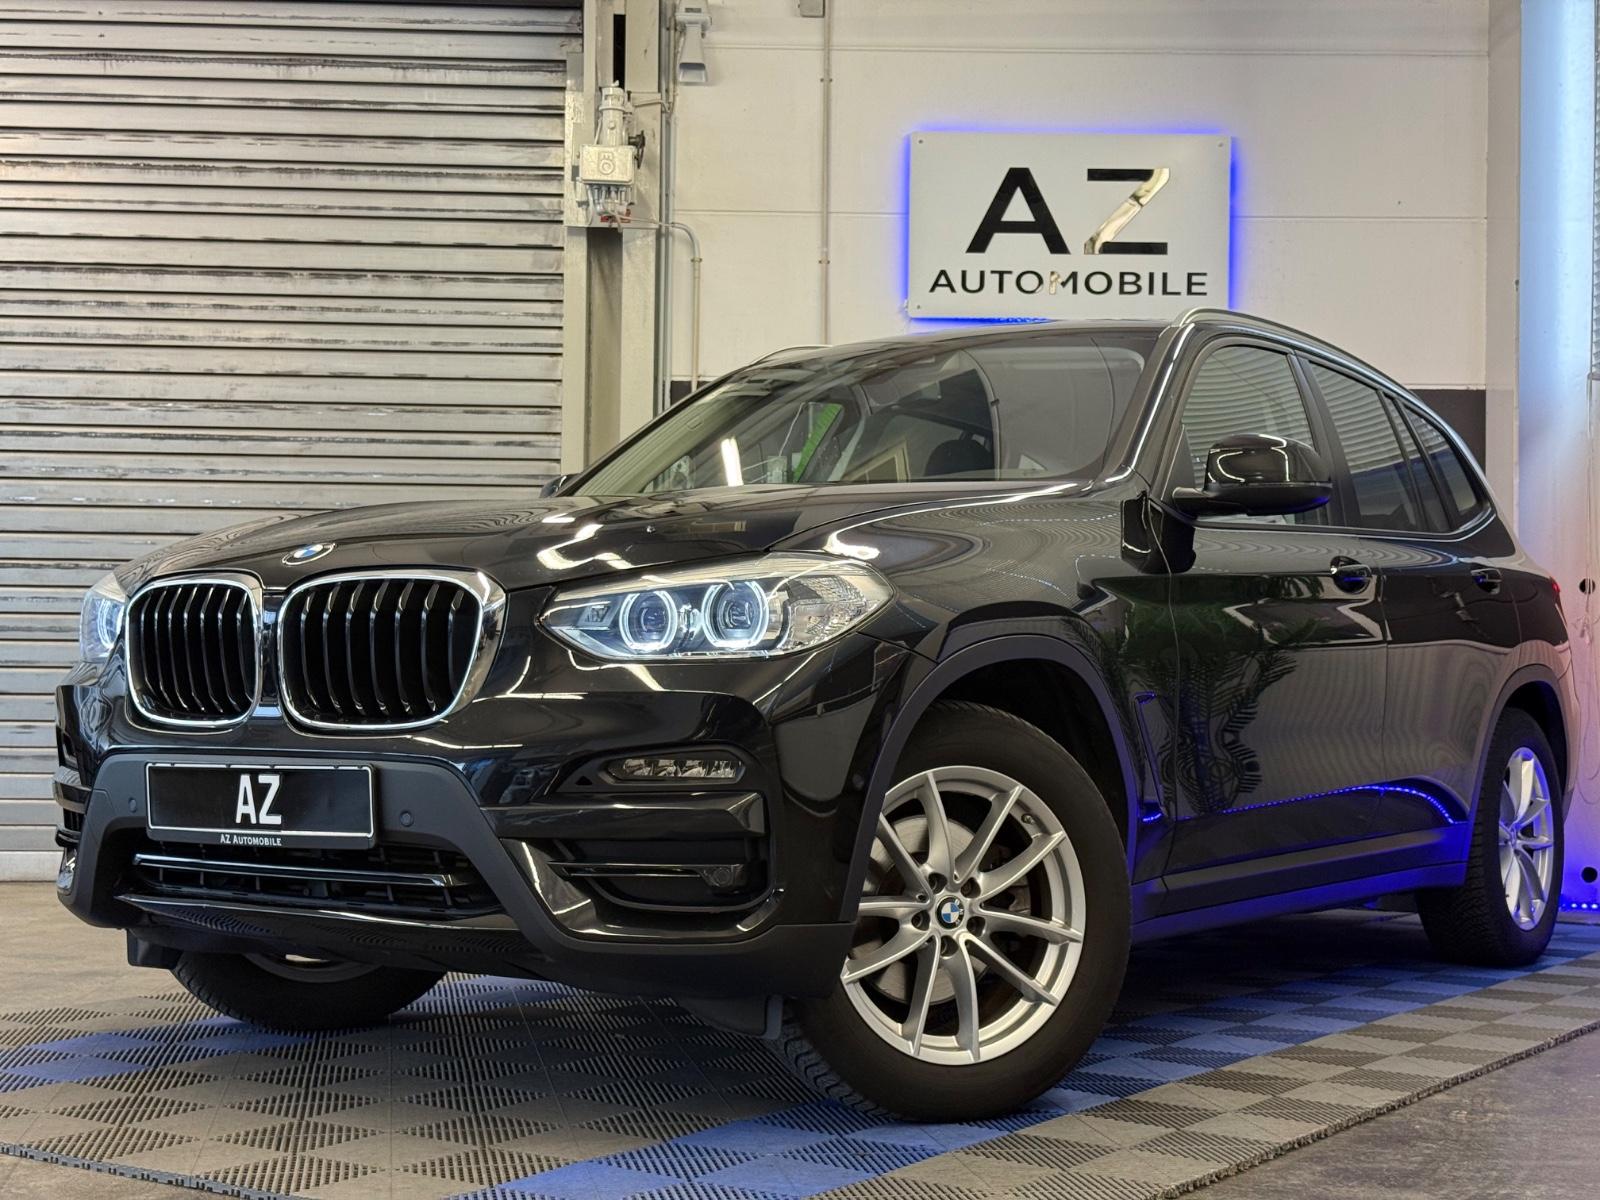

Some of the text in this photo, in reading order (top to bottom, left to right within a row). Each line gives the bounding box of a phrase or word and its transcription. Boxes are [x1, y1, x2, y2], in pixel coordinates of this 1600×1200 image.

[966, 167, 1170, 255] AZ
[929, 269, 1208, 296] AUTOMOBILE
[235, 773, 282, 825] AZ
[220, 833, 231, 844] AZ
